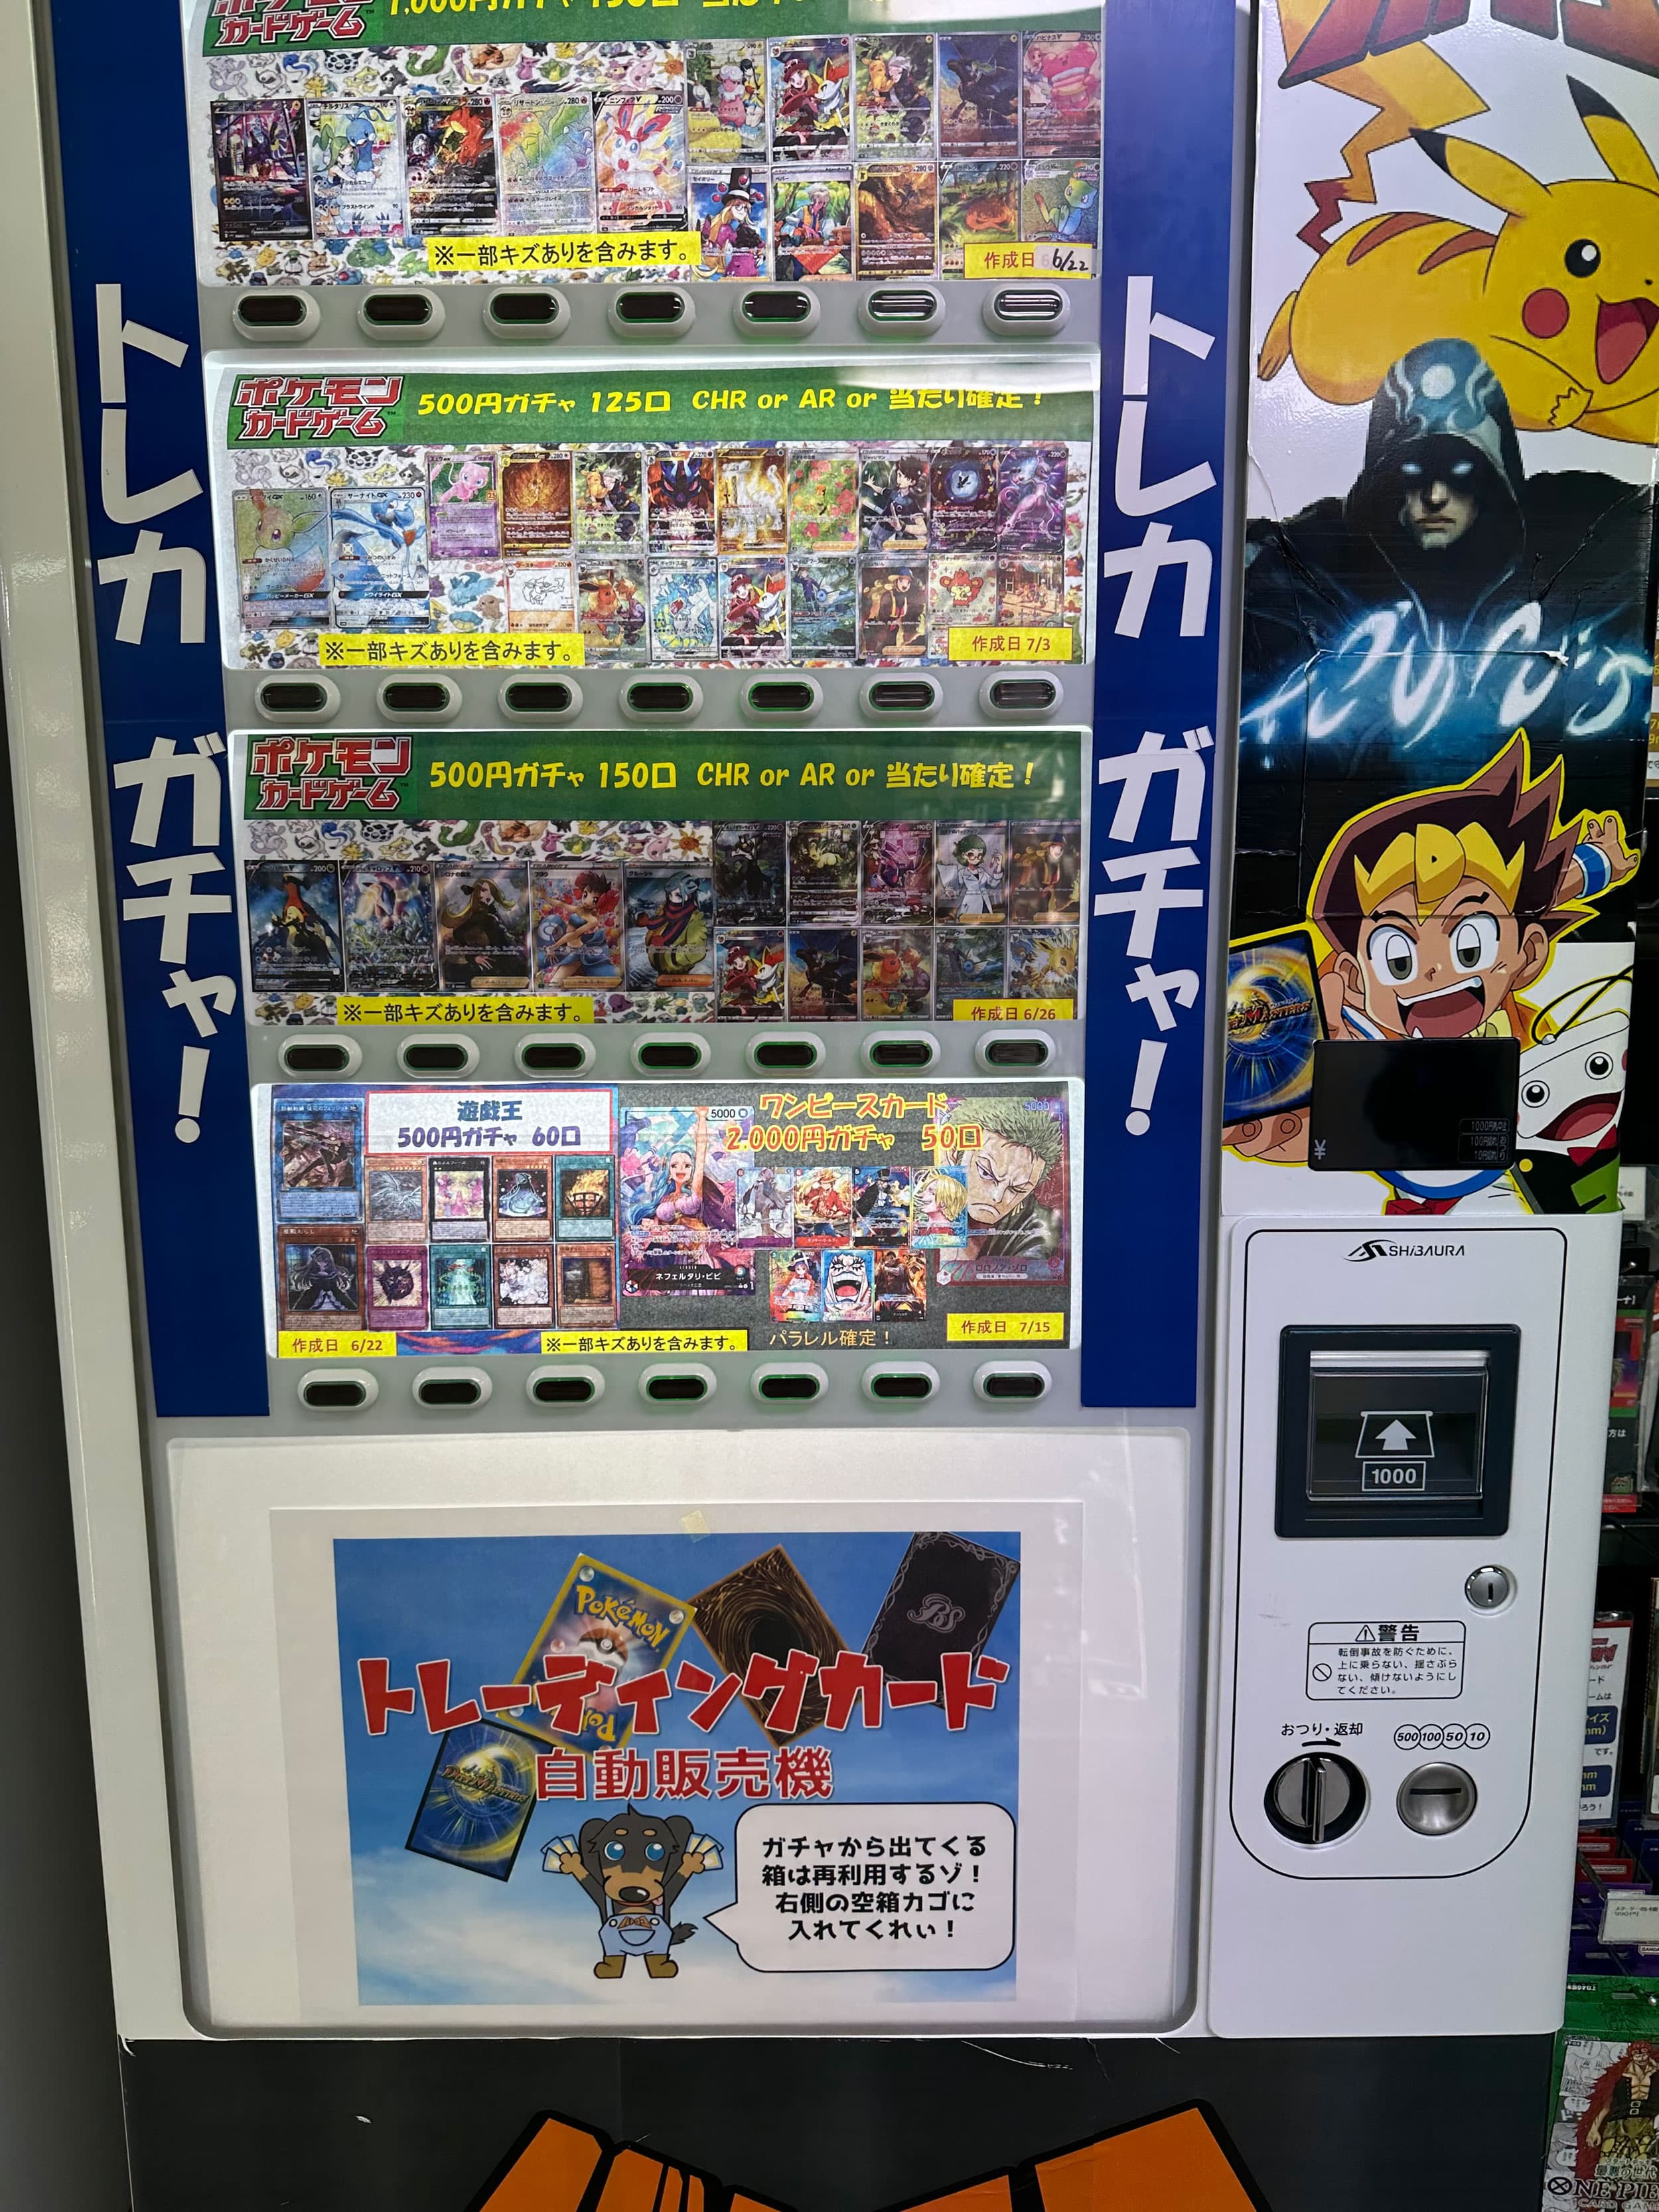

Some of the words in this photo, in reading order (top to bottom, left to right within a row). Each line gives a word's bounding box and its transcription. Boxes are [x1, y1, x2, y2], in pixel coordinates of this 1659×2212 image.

[215, 6, 365, 47] カードゲーム
[433, 239, 687, 267] ※一部キズありを含みます。
[983, 251, 1035, 269] 作成日
[1052, 248, 1089, 271] 6/22
[234, 375, 405, 407] ポケモン
[417, 391, 577, 416] 500円ガチャ
[591, 390, 670, 413] 125口
[692, 389, 747, 409] CHR
[757, 392, 788, 409] or
[799, 388, 836, 409] AR
[845, 392, 876, 409] or
[234, 406, 388, 440] カードゲーム
[94, 282, 206, 646] トレカ
[1102, 275, 1218, 639] トレカ
[325, 640, 571, 662] ※一部キズありを含みます。
[972, 635, 1021, 652] 作成日
[1027, 636, 1051, 652] 7/3
[250, 735, 413, 776] ポケモン
[429, 761, 584, 790] 500円ガチャ
[599, 761, 677, 789] 150口
[697, 762, 750, 787] CHR
[760, 767, 790, 786] or
[799, 762, 835, 786] AR
[845, 767, 875, 786] or
[885, 761, 1035, 790] 当たり確定！
[255, 778, 399, 811] カードゲーム
[344, 1003, 580, 1023] ※一部キズありを含みます。
[971, 1006, 1018, 1021] 作成日
[1023, 1007, 1056, 1021] 6/26
[457, 1100, 523, 1122] 遊戯王
[710, 1109, 736, 1118] 5000
[759, 1091, 950, 1121] ワンピースカード
[397, 1126, 518, 1148] 500円ガチャ
[532, 1126, 582, 1147] 60口
[920, 1124, 983, 1152] 50口
[655, 1272, 722, 1282] ネフェルタリ・ビビ
[768, 1329, 891, 1347] パラレル確定！
[960, 1319, 1008, 1335] 作成日
[1019, 1319, 1050, 1333] 7/15
[292, 1337, 338, 1353] 作成日
[351, 1339, 384, 1352] 6/22
[545, 1336, 737, 1353] ※一部キズありを含みます。
[1370, 1468, 1417, 1485] 1000
[1377, 1623, 1420, 1643] 警告
[1337, 1646, 1455, 1658] 転倒事故を防ぐために、
[1336, 1659, 1458, 1670] 上に乗らない、揺さぶら
[1336, 1671, 1457, 1682] ない、傾けないようにし
[356, 1650, 1013, 1735] トレーディングカード
[1336, 1685, 1397, 1696] てください。
[1281, 1722, 1363, 1737] おつり・返却
[1396, 1732, 1419, 1742] 500
[1421, 1732, 1441, 1742] 100
[1445, 1732, 1464, 1742] 50
[1469, 1732, 1486, 1742] 10
[534, 1745, 835, 1803] 自動販売機
[762, 1832, 988, 1860] ガチャから出てくる
[761, 1862, 979, 1886] 箱は再利用するゾ！
[774, 1889, 975, 1915] 右側の空箱カゴに
